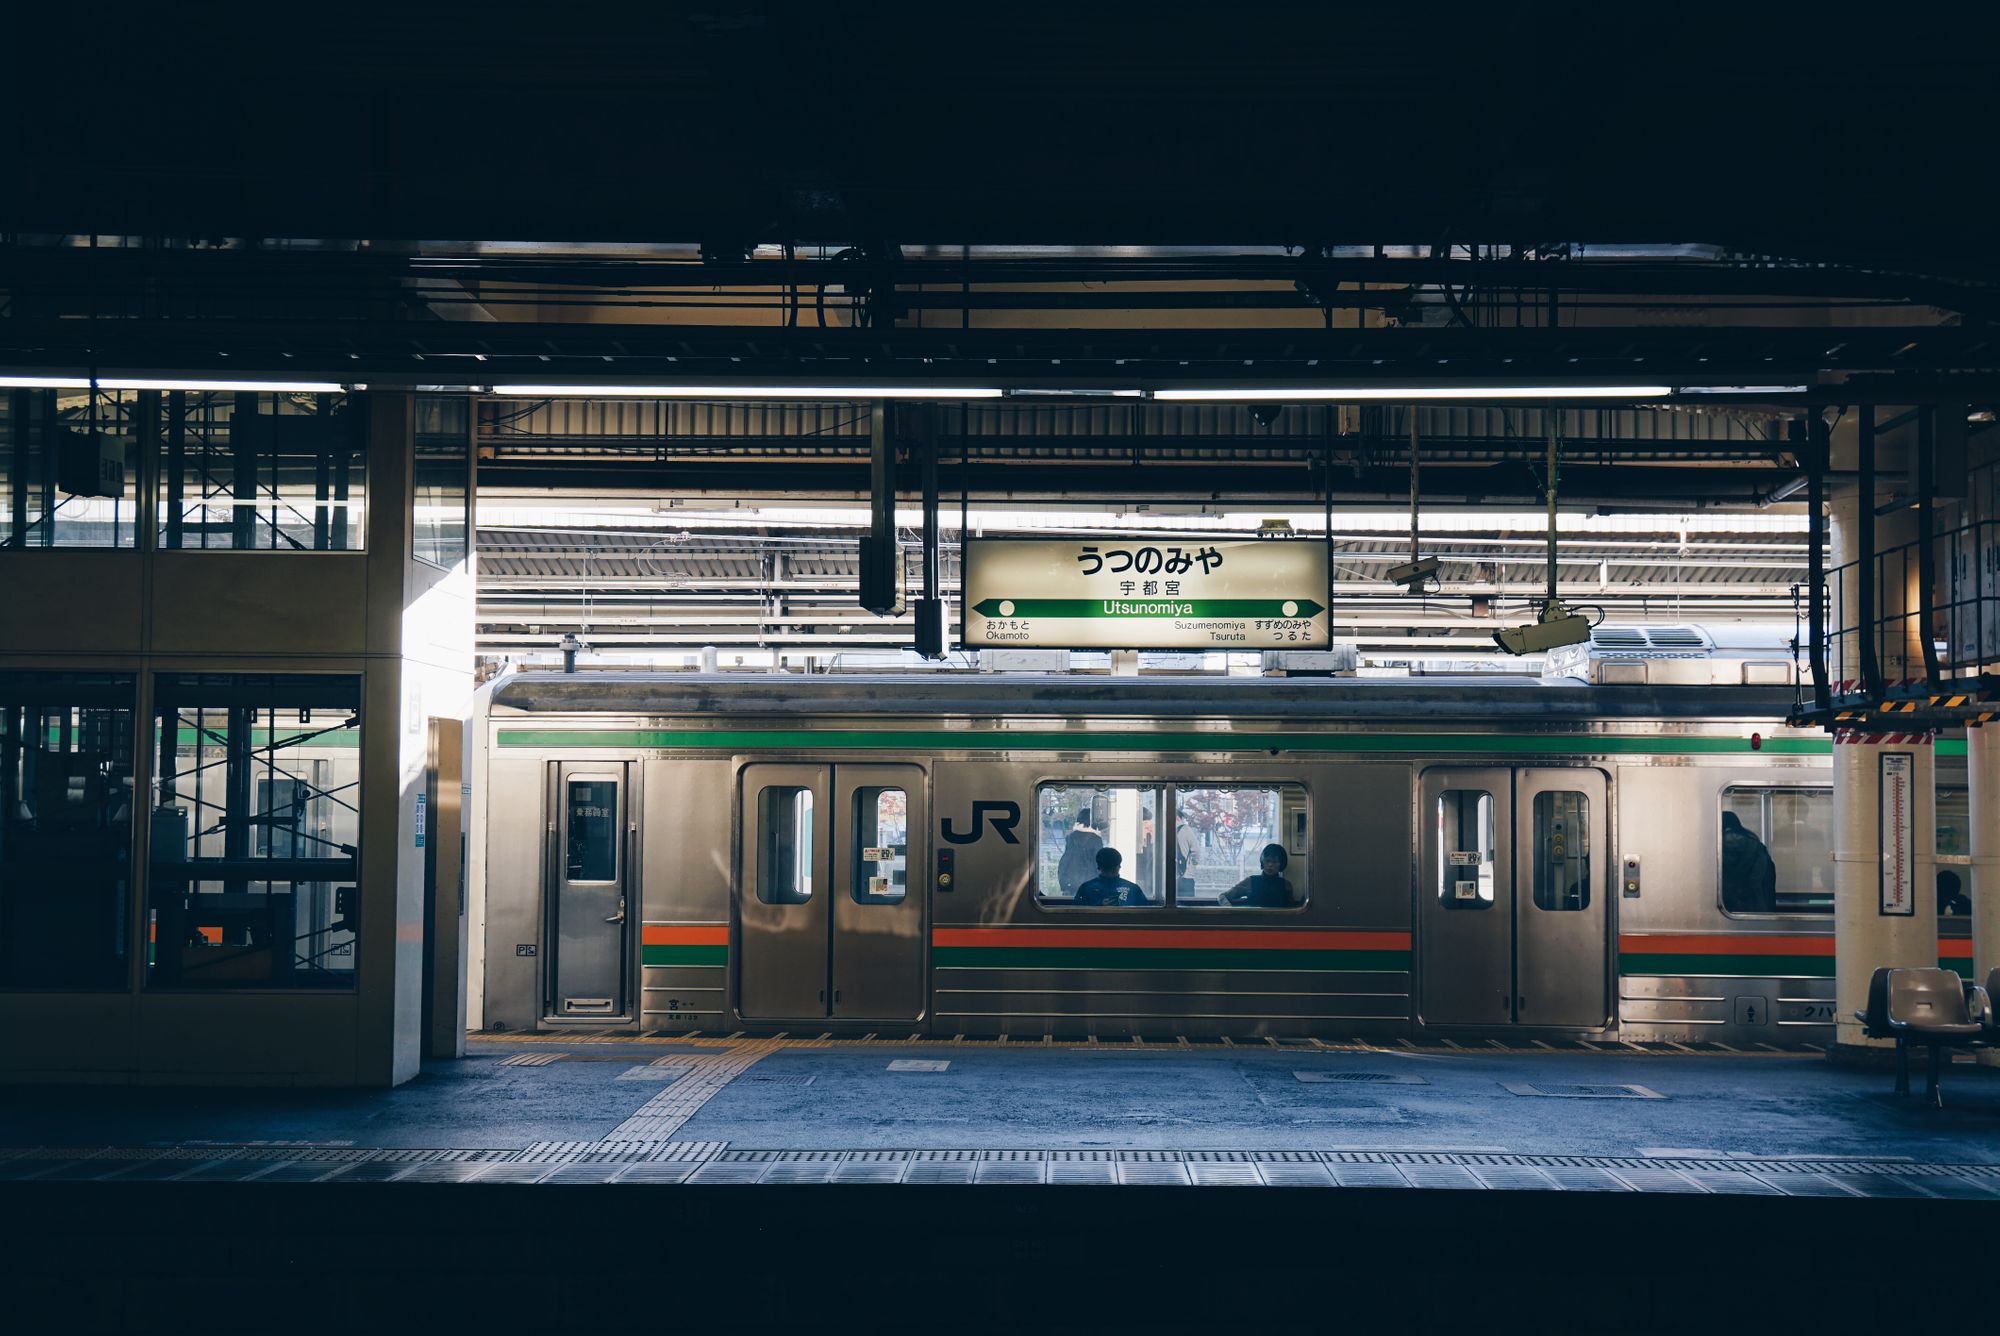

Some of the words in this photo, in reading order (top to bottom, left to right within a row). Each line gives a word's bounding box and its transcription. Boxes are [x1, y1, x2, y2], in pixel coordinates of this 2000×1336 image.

[1077, 546, 1224, 576] うつのみや
[1120, 580, 1180, 596] 宇都宮
[1103, 600, 1193, 618] Utsunomiya
[986, 620, 1030, 631] おかもと
[1174, 620, 1246, 632] Suzumenomiya
[1255, 619, 1312, 631] すずめのみや
[986, 631, 1030, 641] Okamoto
[1210, 631, 1246, 641] Tsuruta
[1273, 631, 1312, 641] つるた
[941, 801, 1021, 844] JR
